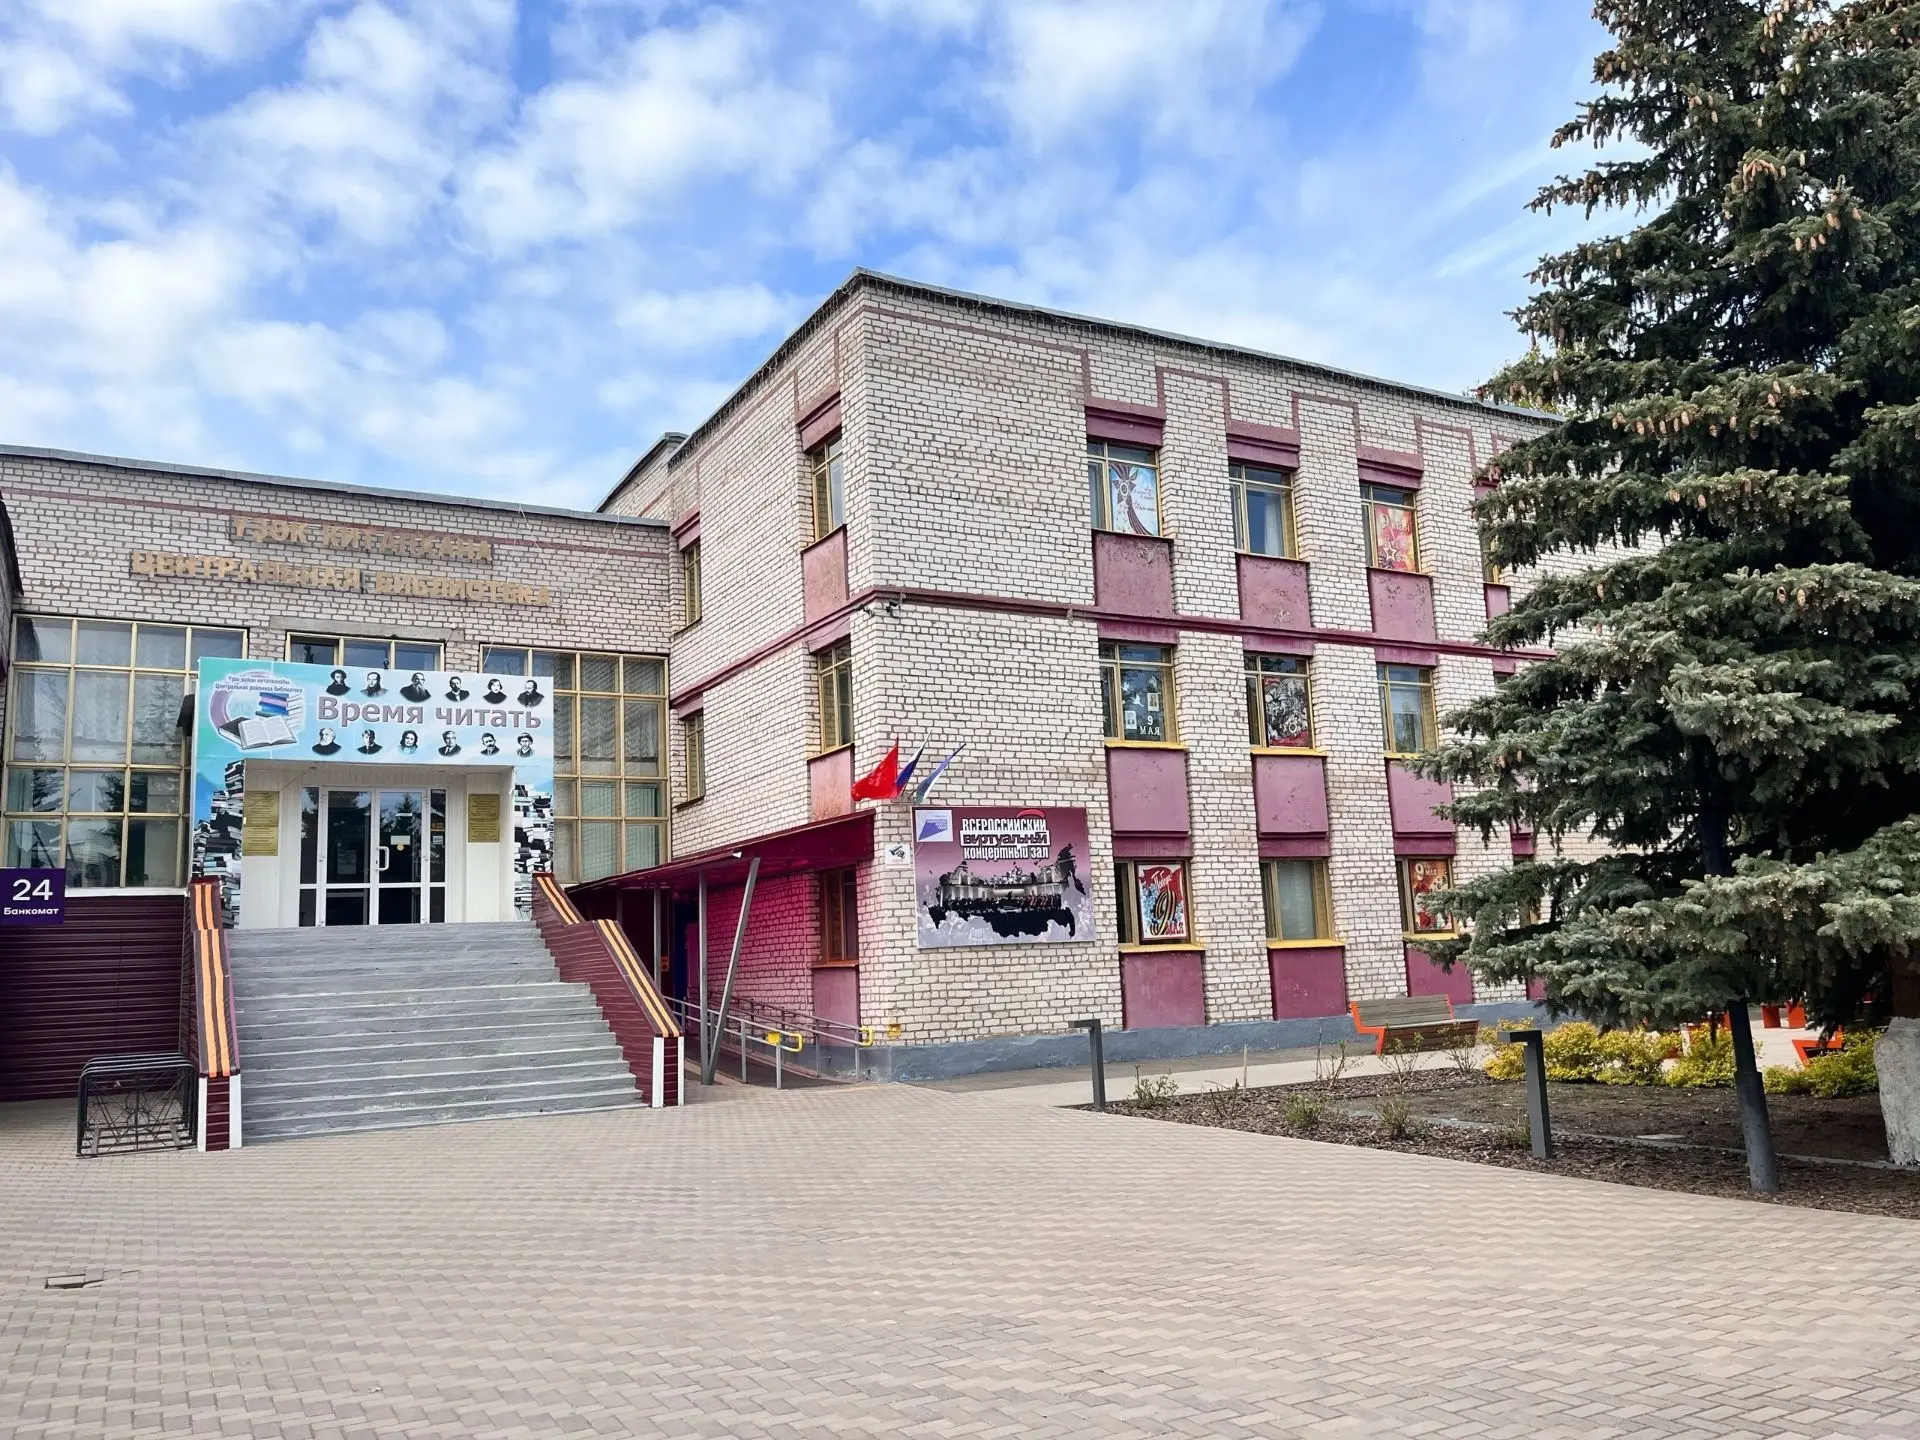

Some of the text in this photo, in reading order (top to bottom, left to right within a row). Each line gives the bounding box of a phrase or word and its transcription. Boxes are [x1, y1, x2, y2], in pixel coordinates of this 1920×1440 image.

[131, 551, 551, 606] ЦЕНТРАЛЬНАЯ БИБЛИОТЕКА
[317, 695, 542, 729] Время читать
[1147, 715, 1154, 726] 9
[1139, 725, 1160, 736] МАЯ
[964, 846, 1049, 861] концертный зал
[12, 878, 53, 901] 24
[3, 907, 59, 915] Банкомат
